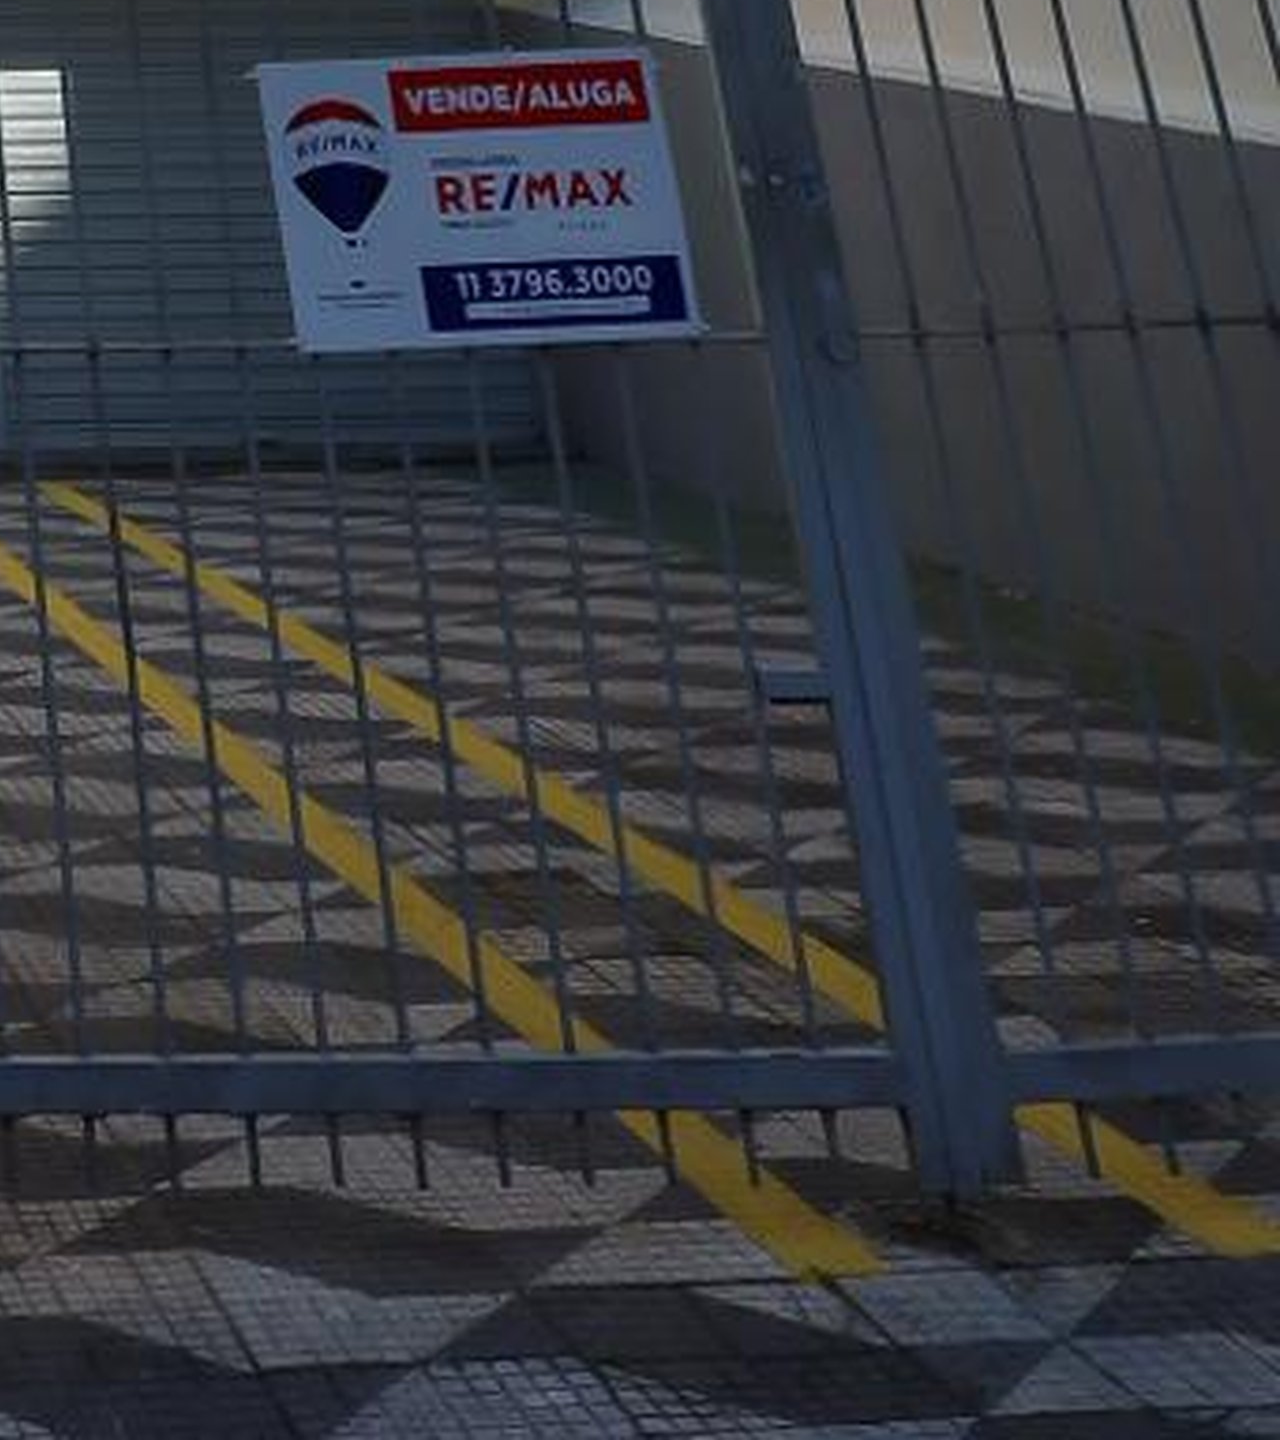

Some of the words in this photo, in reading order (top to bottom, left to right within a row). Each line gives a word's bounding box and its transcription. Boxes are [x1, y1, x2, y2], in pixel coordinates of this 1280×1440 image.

[402, 79, 638, 116] VENDE/ALUGA
[436, 167, 634, 214] RE/MAX
[455, 272, 481, 300] 11
[489, 264, 655, 301] 3796.3000
